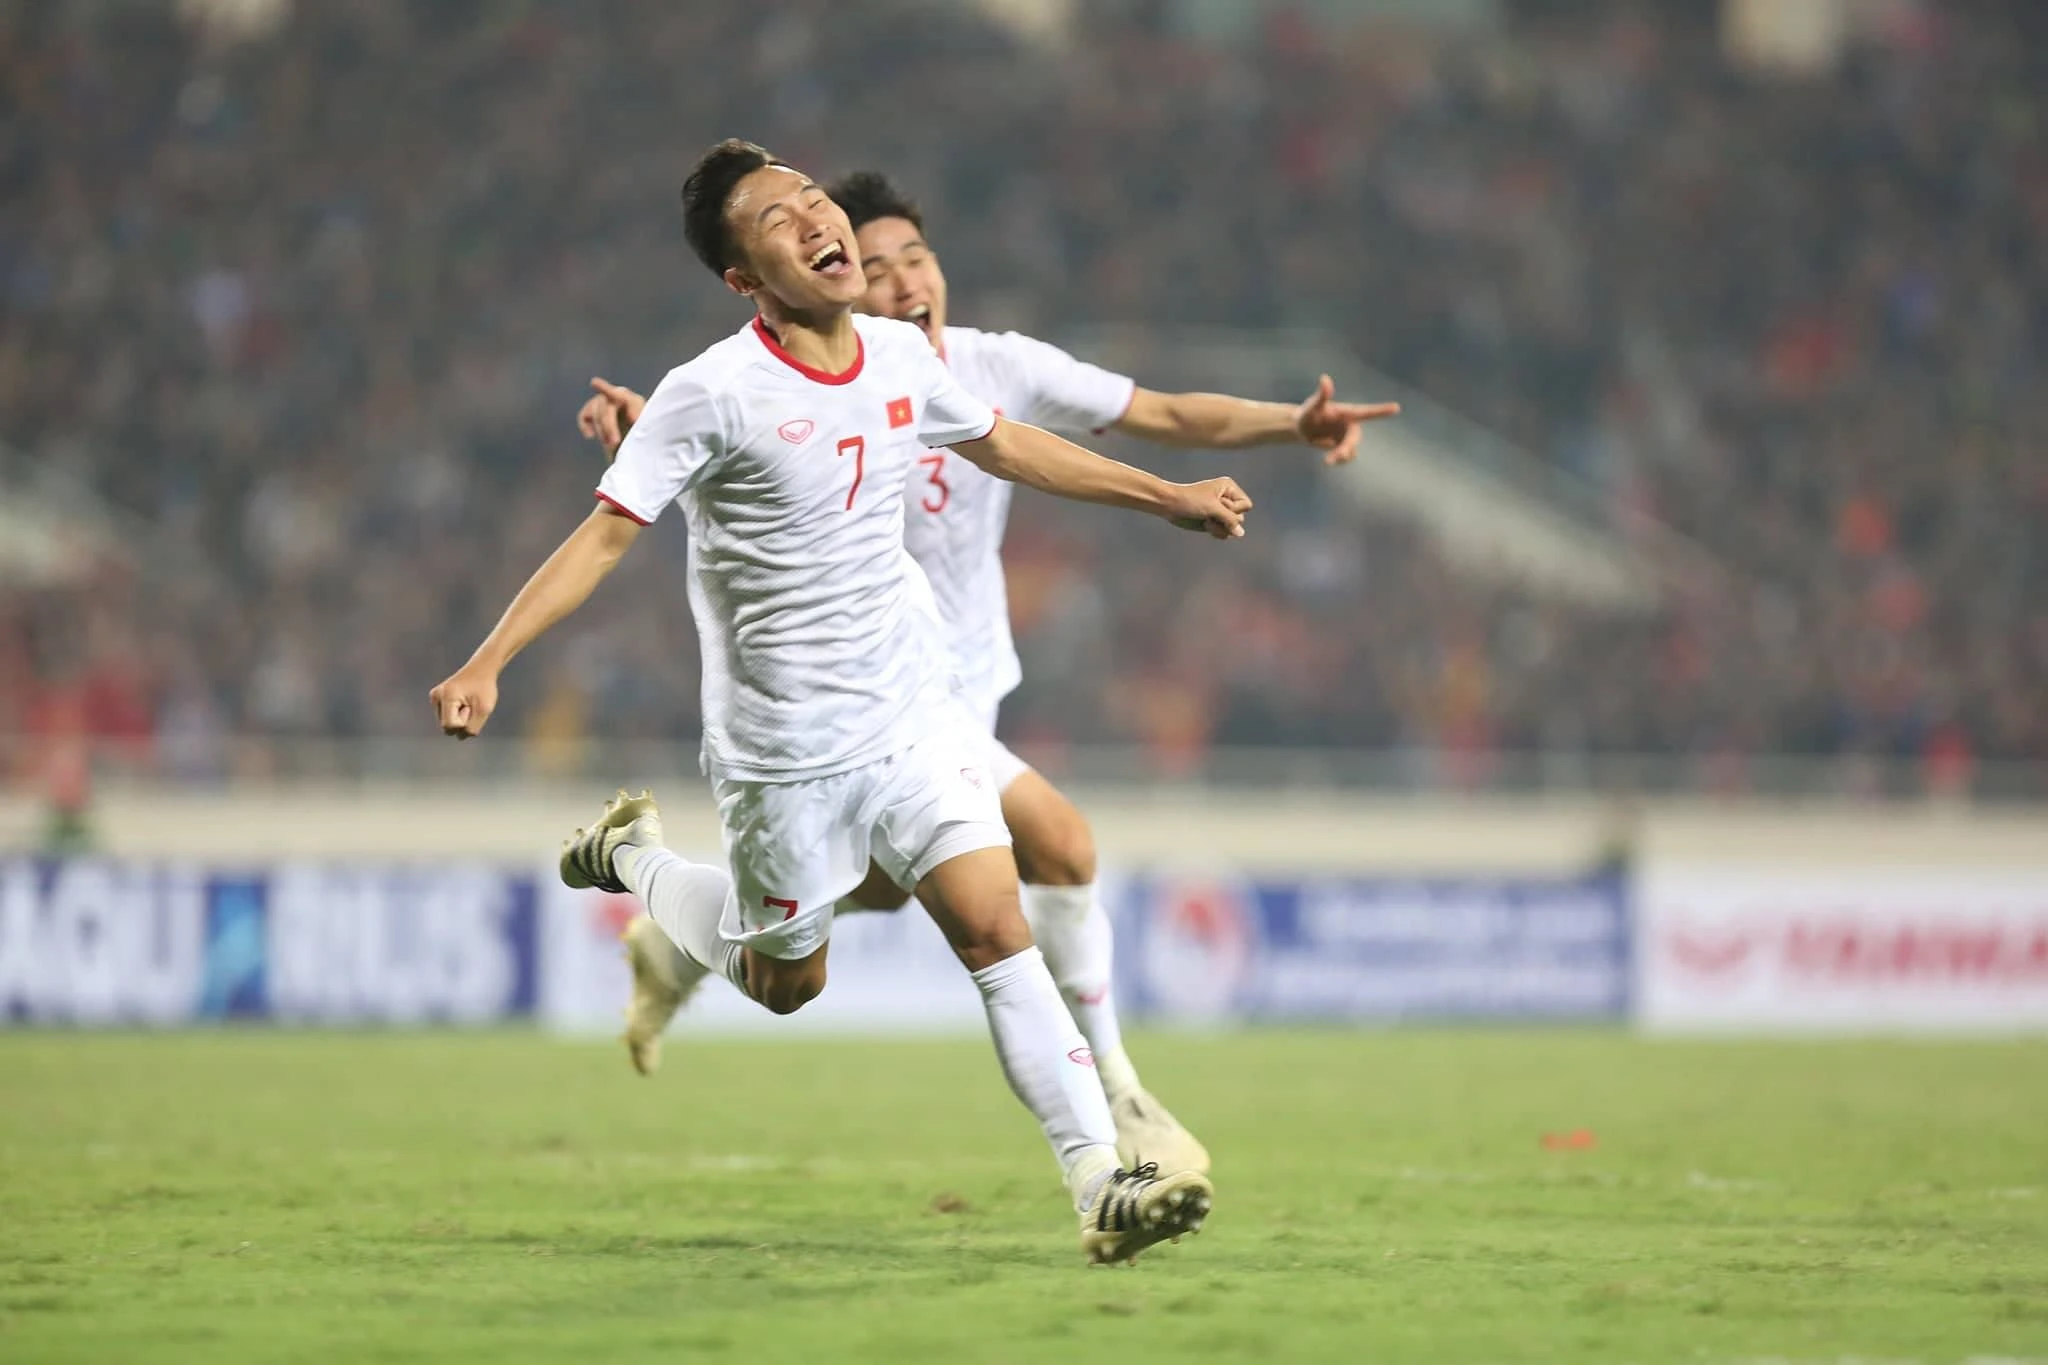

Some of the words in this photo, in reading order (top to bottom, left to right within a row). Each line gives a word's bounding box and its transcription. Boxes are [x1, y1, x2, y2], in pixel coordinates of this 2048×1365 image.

[837, 435, 864, 511] 7
[917, 454, 949, 513] 3
[763, 895, 798, 921] 7
